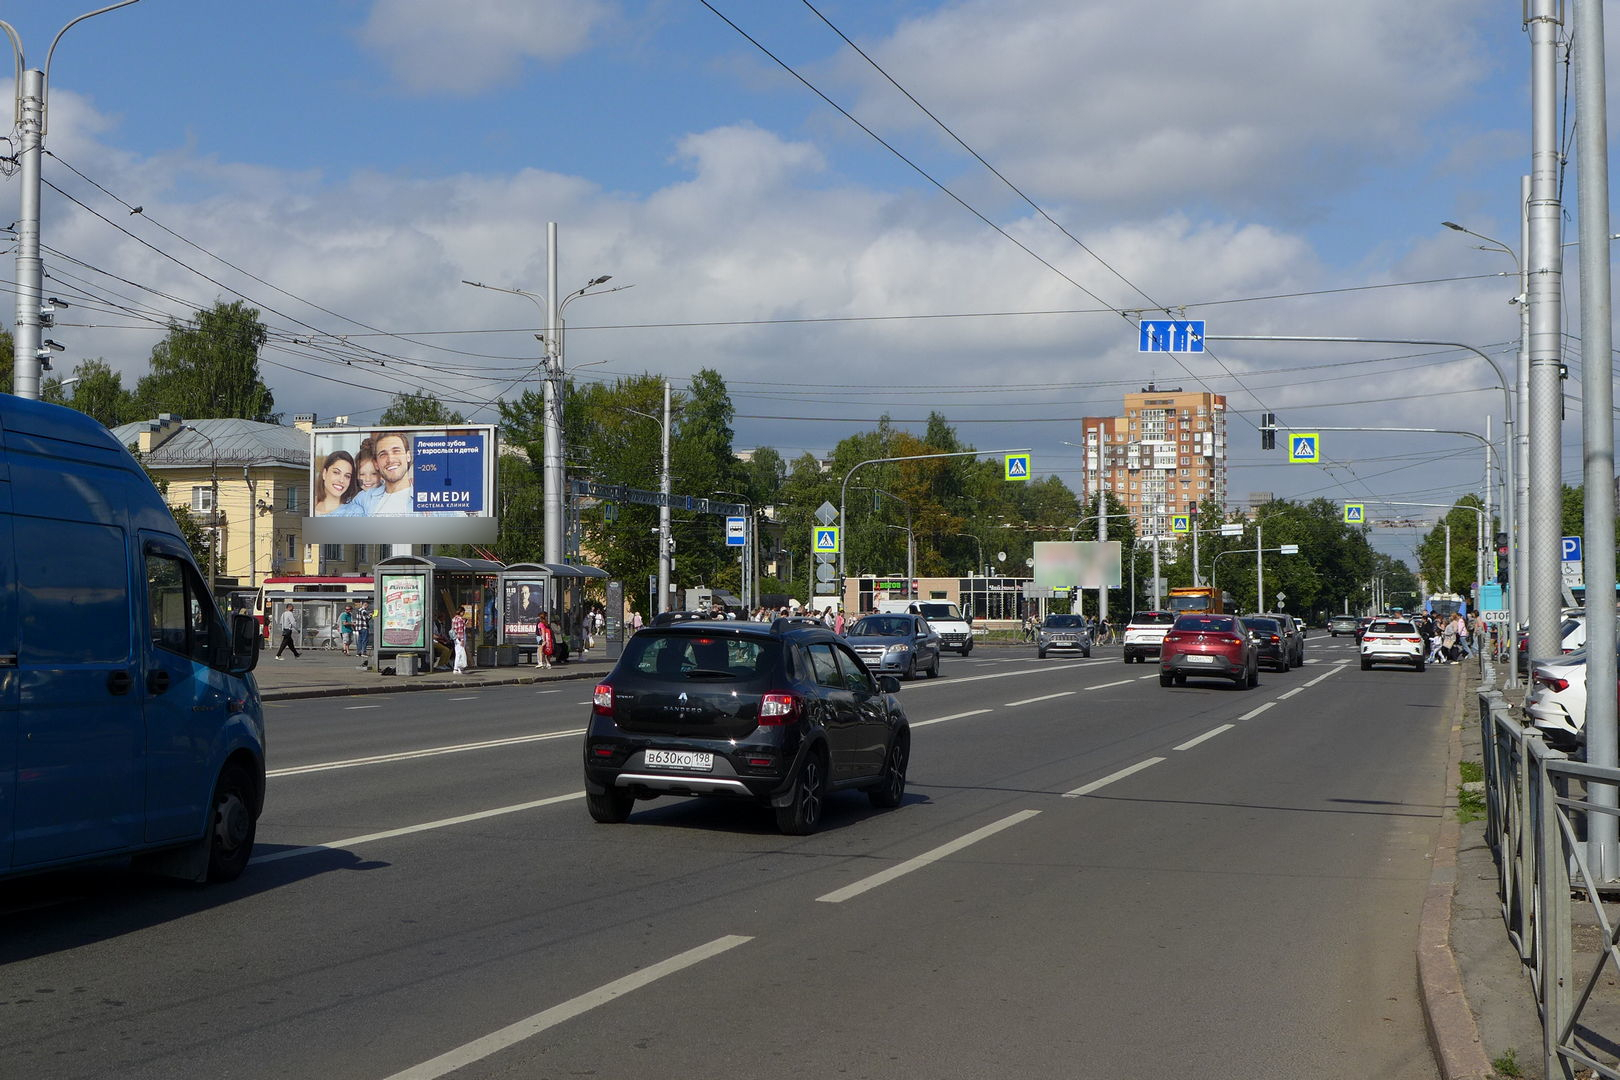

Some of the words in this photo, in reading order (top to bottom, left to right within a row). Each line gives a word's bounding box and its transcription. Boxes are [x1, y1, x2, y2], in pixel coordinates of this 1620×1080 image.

[447, 440, 466, 448] зубов
[1562, 539, 1577, 559] P
[505, 624, 537, 633] РОЗЕНБАУ
[693, 753, 710, 763] 198
